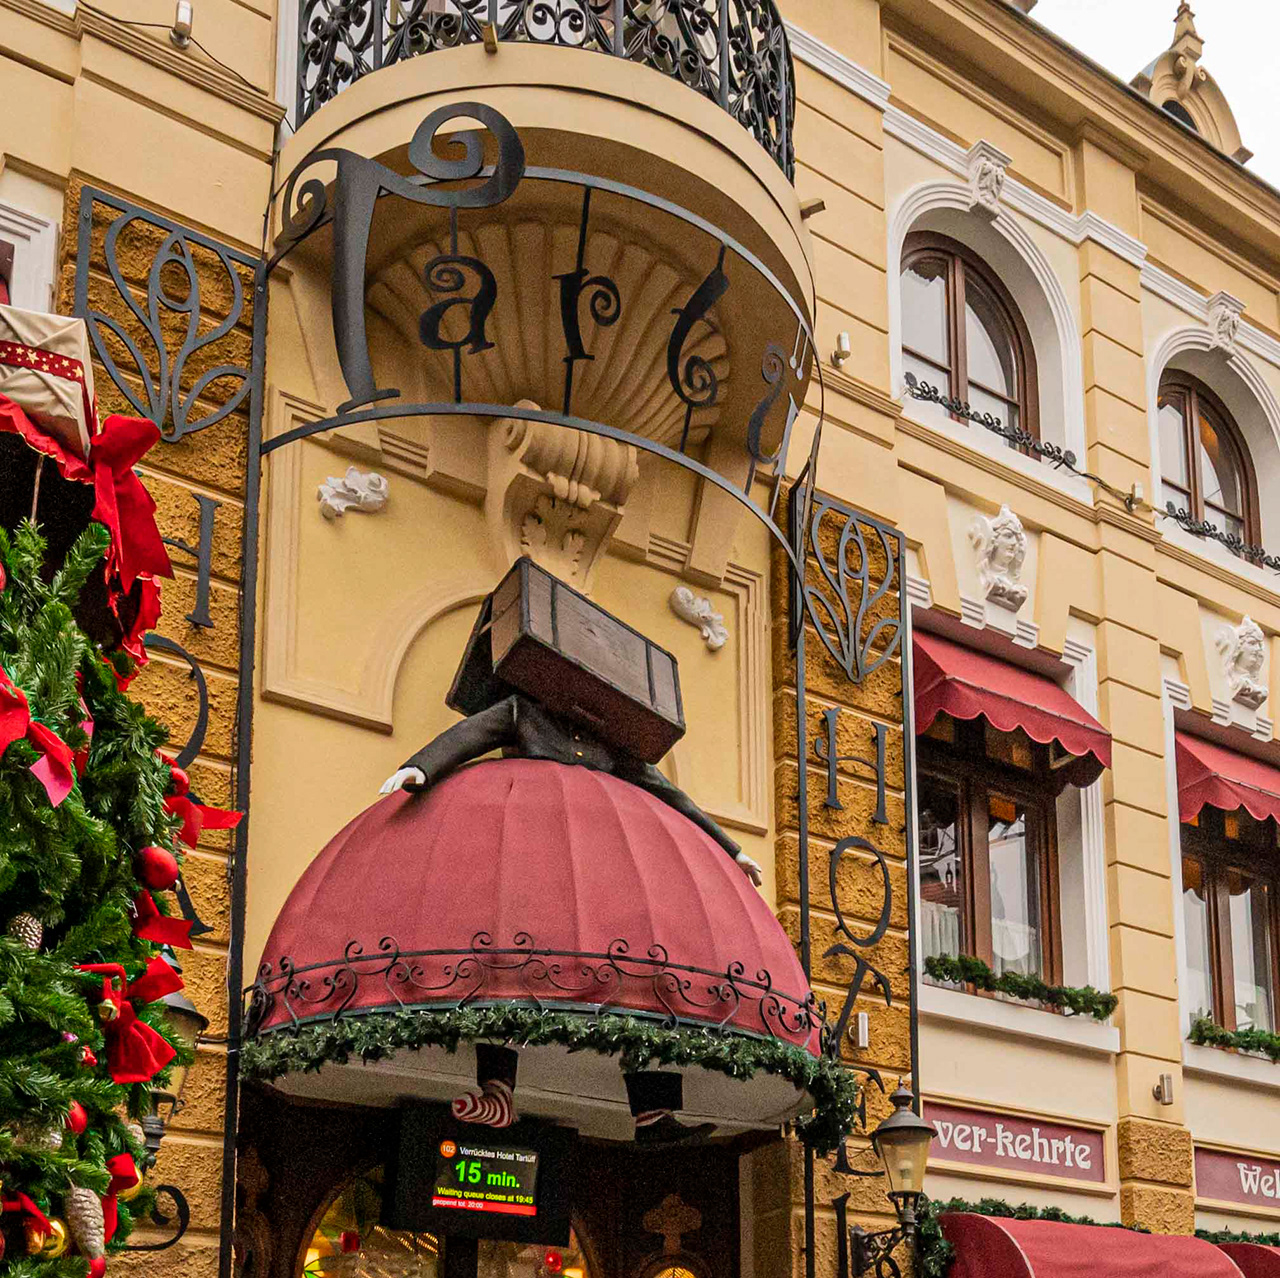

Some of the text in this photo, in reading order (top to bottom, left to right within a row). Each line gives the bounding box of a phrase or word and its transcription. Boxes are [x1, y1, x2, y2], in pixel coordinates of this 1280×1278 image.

[496, 1151, 515, 1160] Hotel
[932, 1119, 1092, 1170] ver-kehrte
[455, 1160, 520, 1188] 15 min.
[437, 1186, 534, 1204] Waiting queue closes at 19:45
